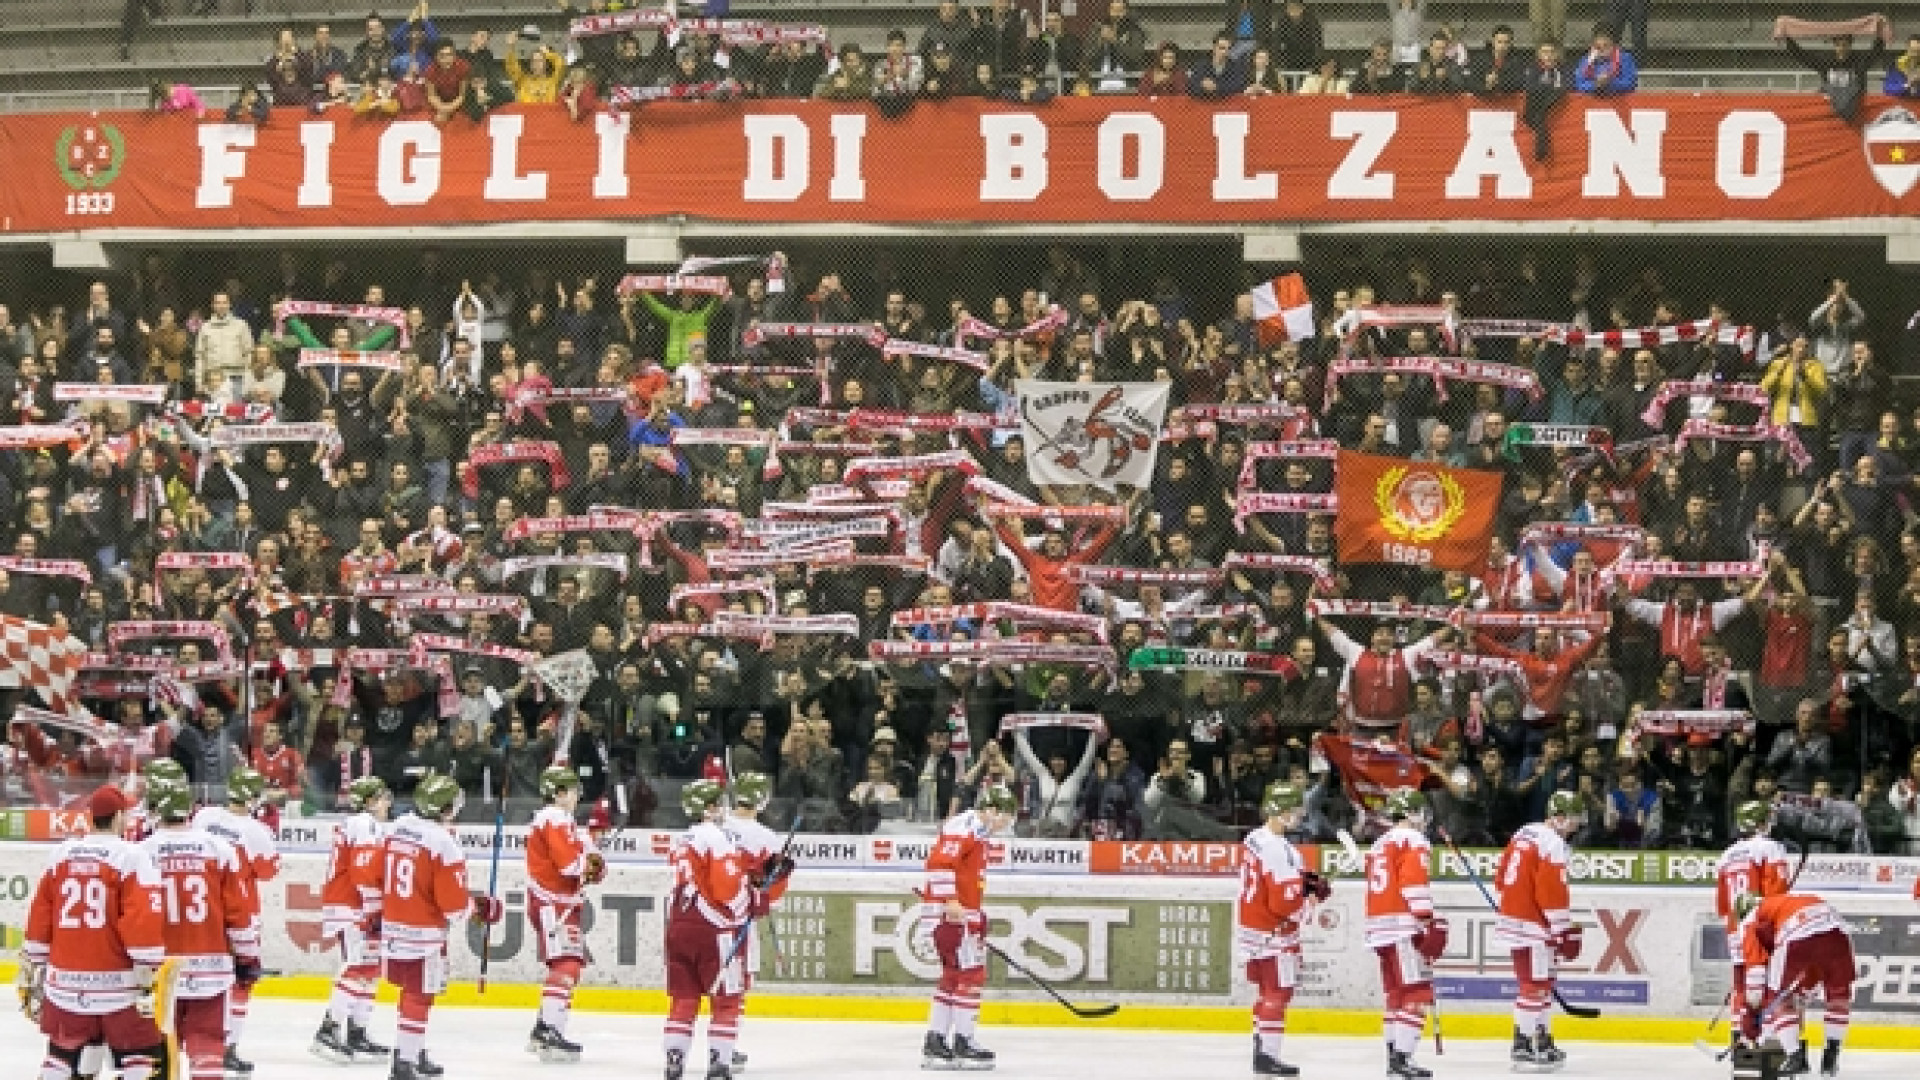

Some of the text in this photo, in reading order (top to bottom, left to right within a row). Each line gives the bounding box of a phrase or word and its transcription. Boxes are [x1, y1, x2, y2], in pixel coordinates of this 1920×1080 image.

[195, 109, 1787, 209] FIGLI DI BOLZANO
[384, 853, 416, 899] 19
[1120, 843, 1239, 865] KAMPI
[57, 876, 107, 929] 29
[165, 873, 209, 924] 13
